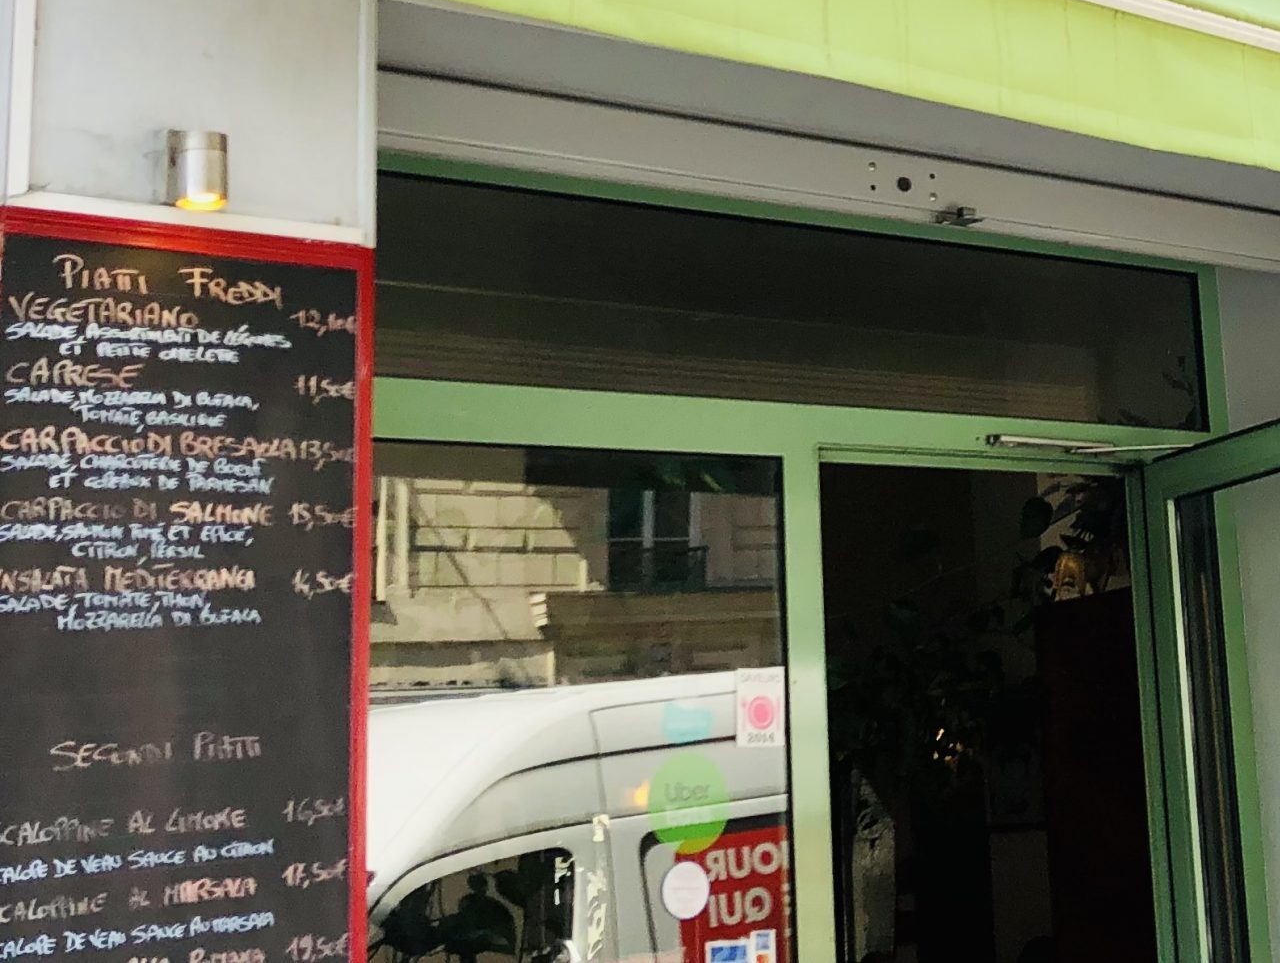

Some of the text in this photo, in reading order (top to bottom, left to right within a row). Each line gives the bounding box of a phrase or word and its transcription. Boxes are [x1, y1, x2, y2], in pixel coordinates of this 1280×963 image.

[8, 291, 199, 328] VEGETARIANO
[197, 328, 222, 344] DE
[6, 357, 145, 388] CAPRESE
[147, 431, 173, 456] DI
[169, 500, 274, 527] SALMONE
[0, 565, 89, 593] NSALATA
[663, 781, 711, 803] Uber
[0, 816, 115, 847] CALOPPINE
[53, 858, 78, 879] DE
[80, 853, 123, 875] VEAU
[127, 849, 187, 870] SAUCE
[63, 930, 87, 953] DE
[88, 927, 127, 950] VEAU
[129, 923, 187, 944] SAUCE
